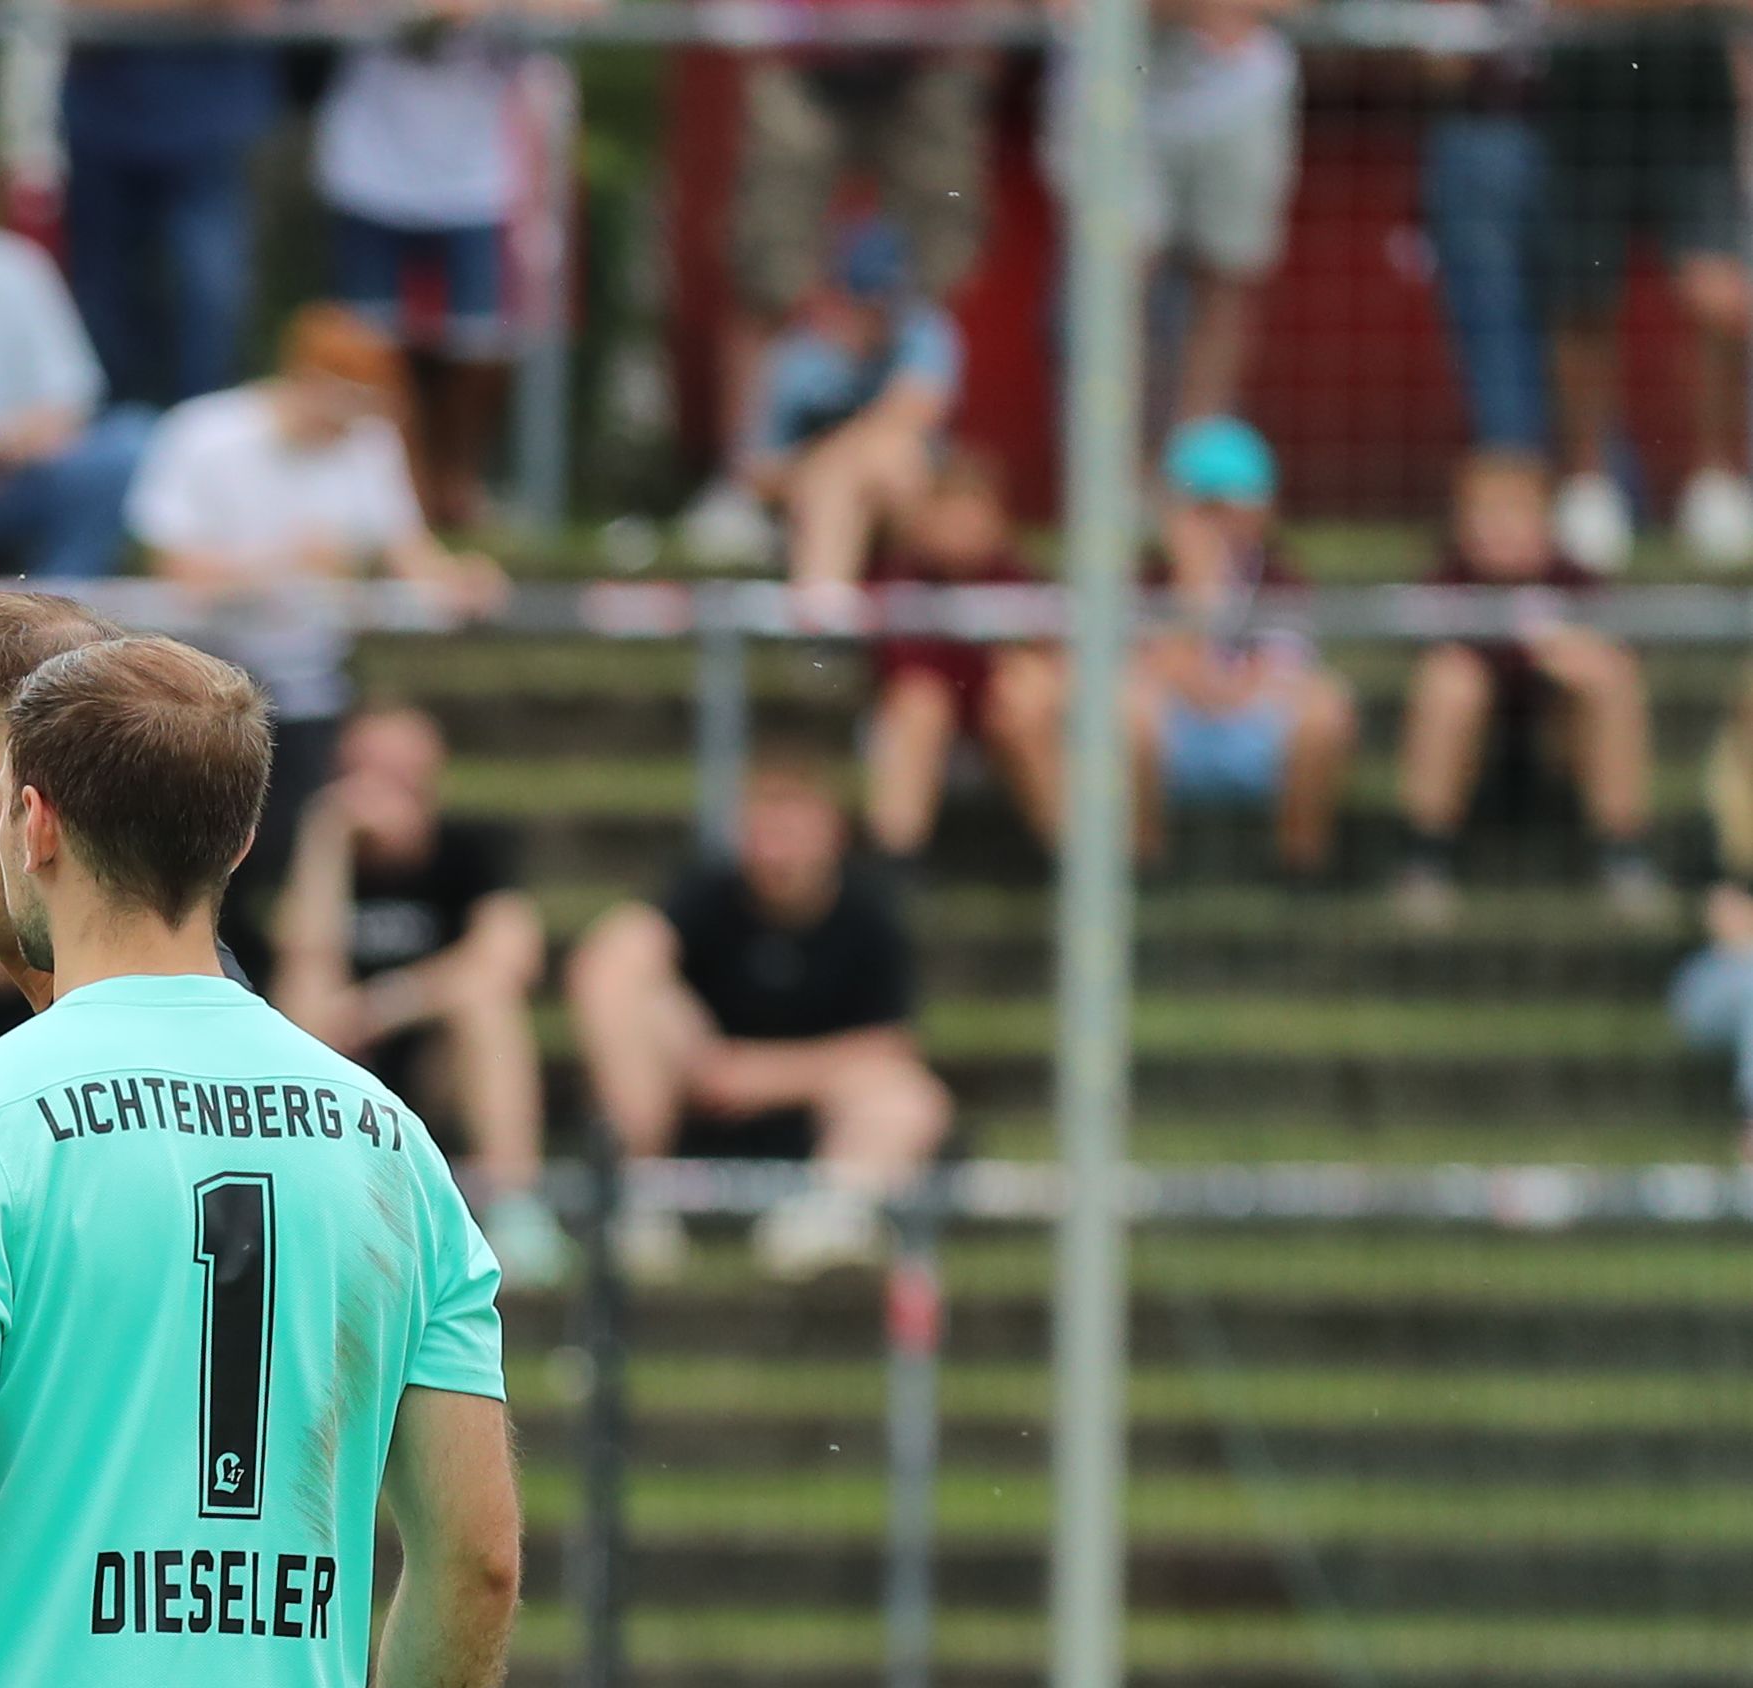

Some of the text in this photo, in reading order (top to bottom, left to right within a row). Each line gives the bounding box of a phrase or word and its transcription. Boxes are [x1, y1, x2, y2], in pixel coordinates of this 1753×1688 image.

[36, 1077, 406, 1153] LICHTENBERG 47
[192, 1171, 277, 1521] 1
[90, 1549, 337, 1640] DIESELER
